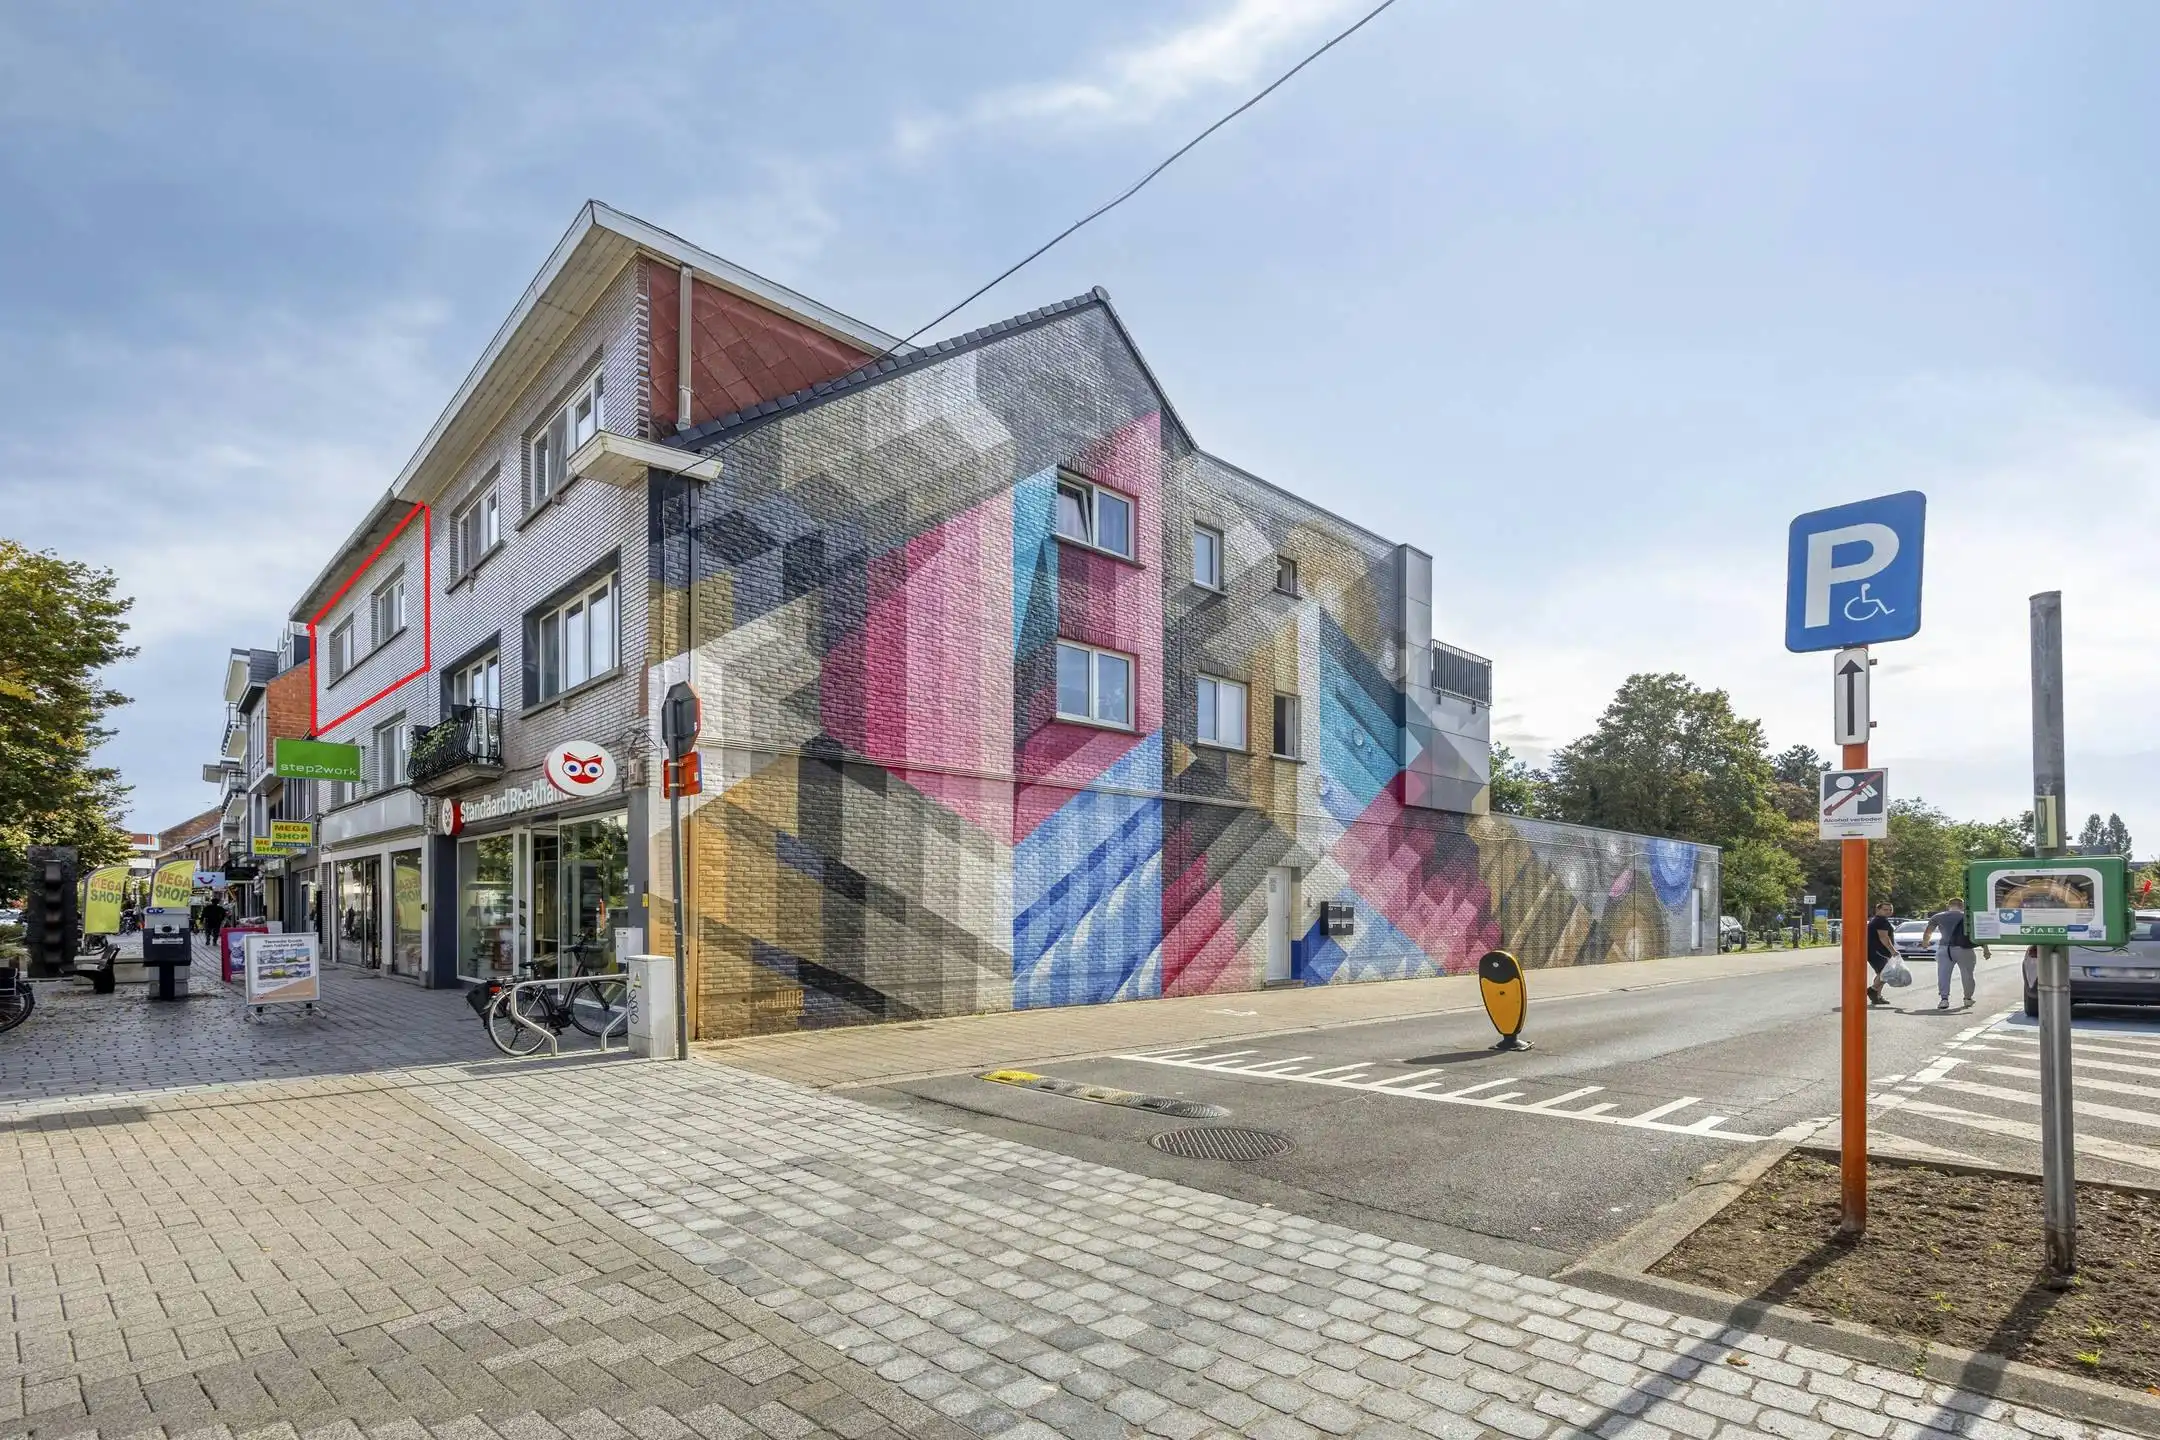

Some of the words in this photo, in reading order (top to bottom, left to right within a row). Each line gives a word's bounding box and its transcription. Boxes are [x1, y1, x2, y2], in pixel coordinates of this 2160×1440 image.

[1805, 523, 1899, 628] P
[280, 763, 356, 776] step2work
[460, 788, 508, 823] Standaard
[510, 778, 570, 813] Boekhan
[274, 825, 309, 833] MEGA
[91, 878, 122, 891] MEGA
[157, 871, 191, 888] MEGA
[90, 889, 122, 904] SHOP
[155, 885, 191, 902] SHOP
